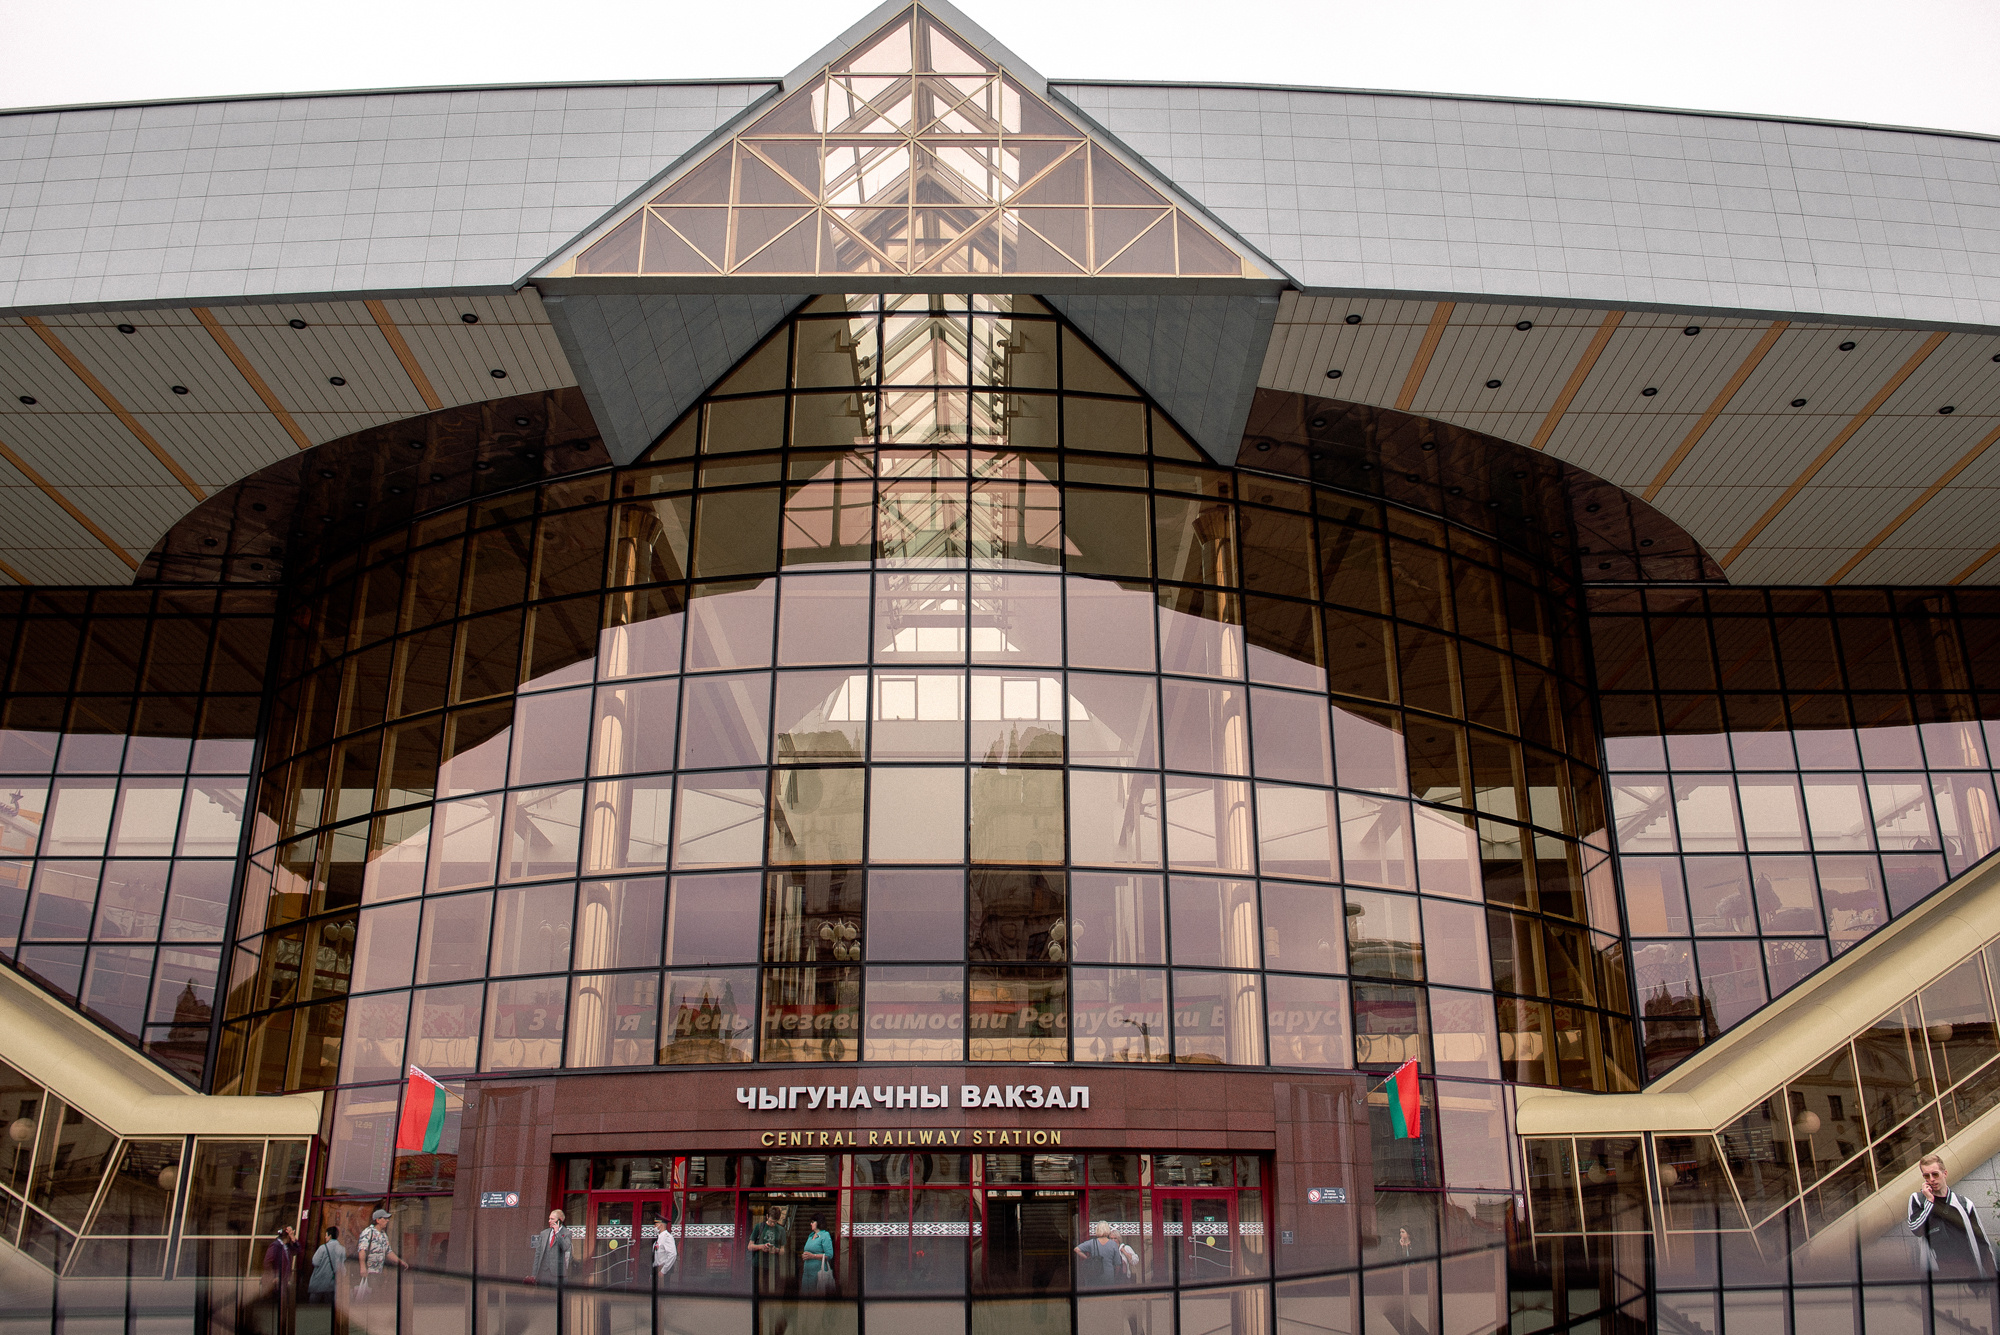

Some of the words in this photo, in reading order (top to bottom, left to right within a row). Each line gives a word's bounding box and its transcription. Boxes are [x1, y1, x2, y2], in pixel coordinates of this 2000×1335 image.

[668, 1008, 749, 1036] День
[736, 1086, 949, 1110] ЧЫГУНАЧНЫ
[961, 1085, 1090, 1109] ВАКЗАЛ
[760, 1131, 857, 1147] CENTRAL
[869, 1130, 961, 1146] RAILWAY
[973, 1130, 1062, 1145] STATION
